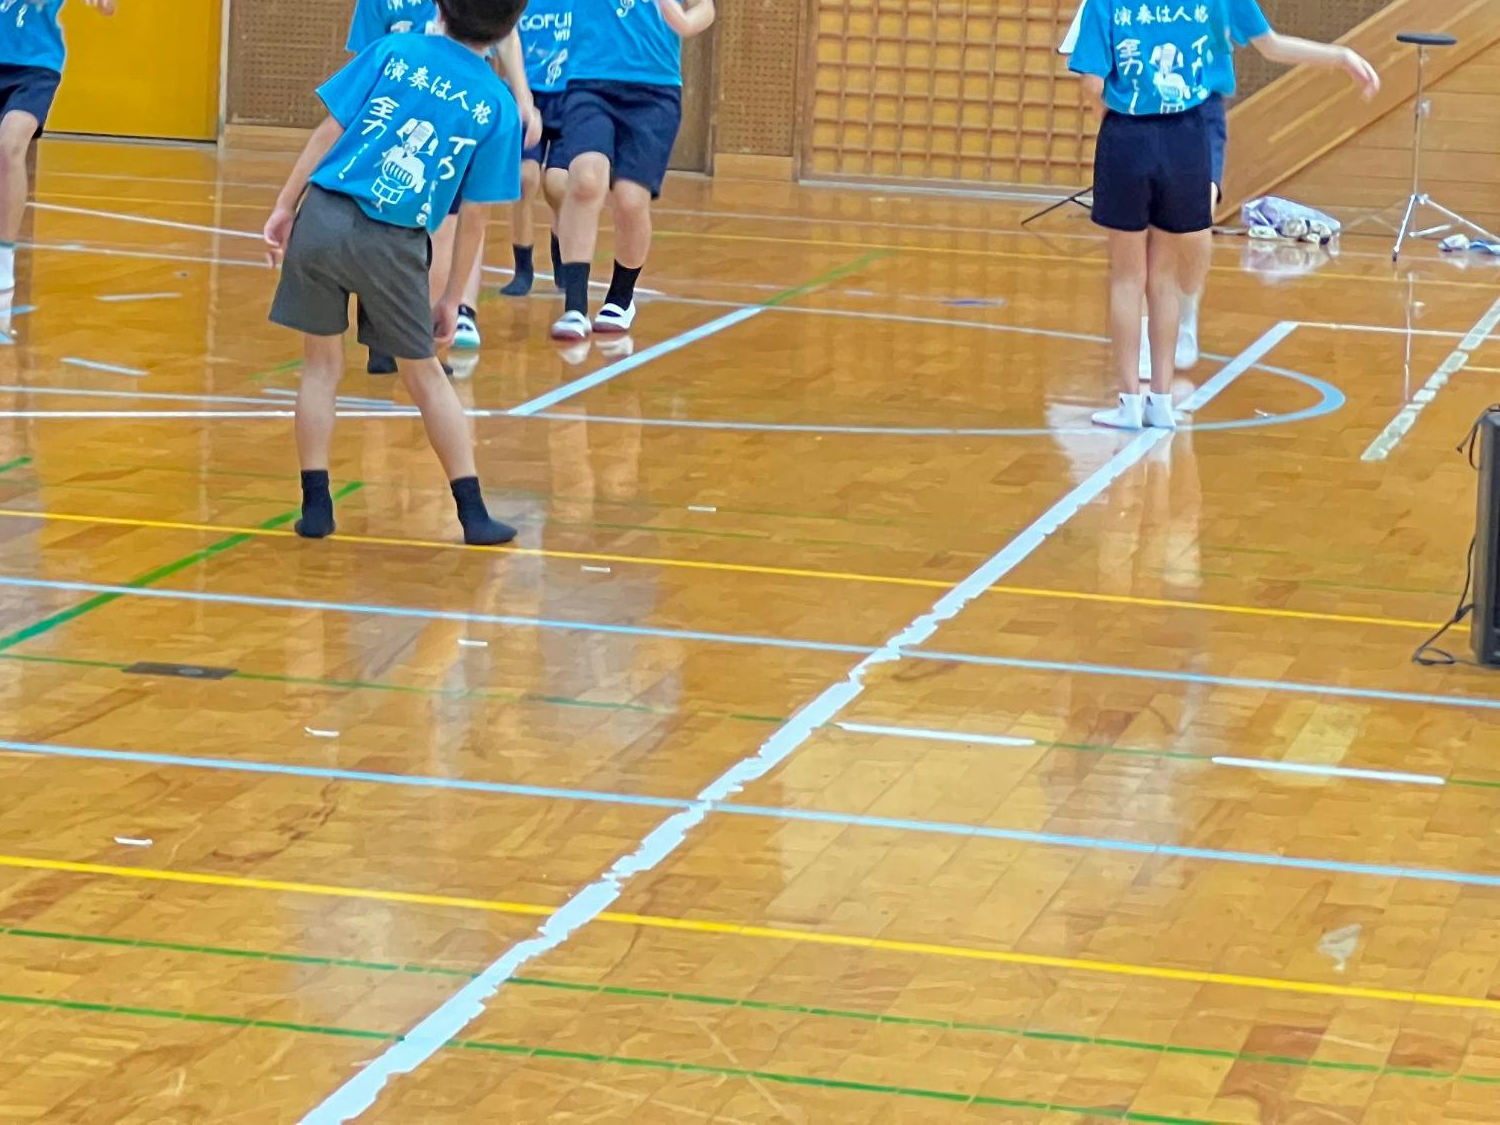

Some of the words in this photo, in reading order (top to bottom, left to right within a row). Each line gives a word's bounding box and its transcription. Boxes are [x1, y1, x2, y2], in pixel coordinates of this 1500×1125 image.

[1114, 4, 1209, 27] 演奏は人格
[383, 56, 493, 126] 演奏は人格
